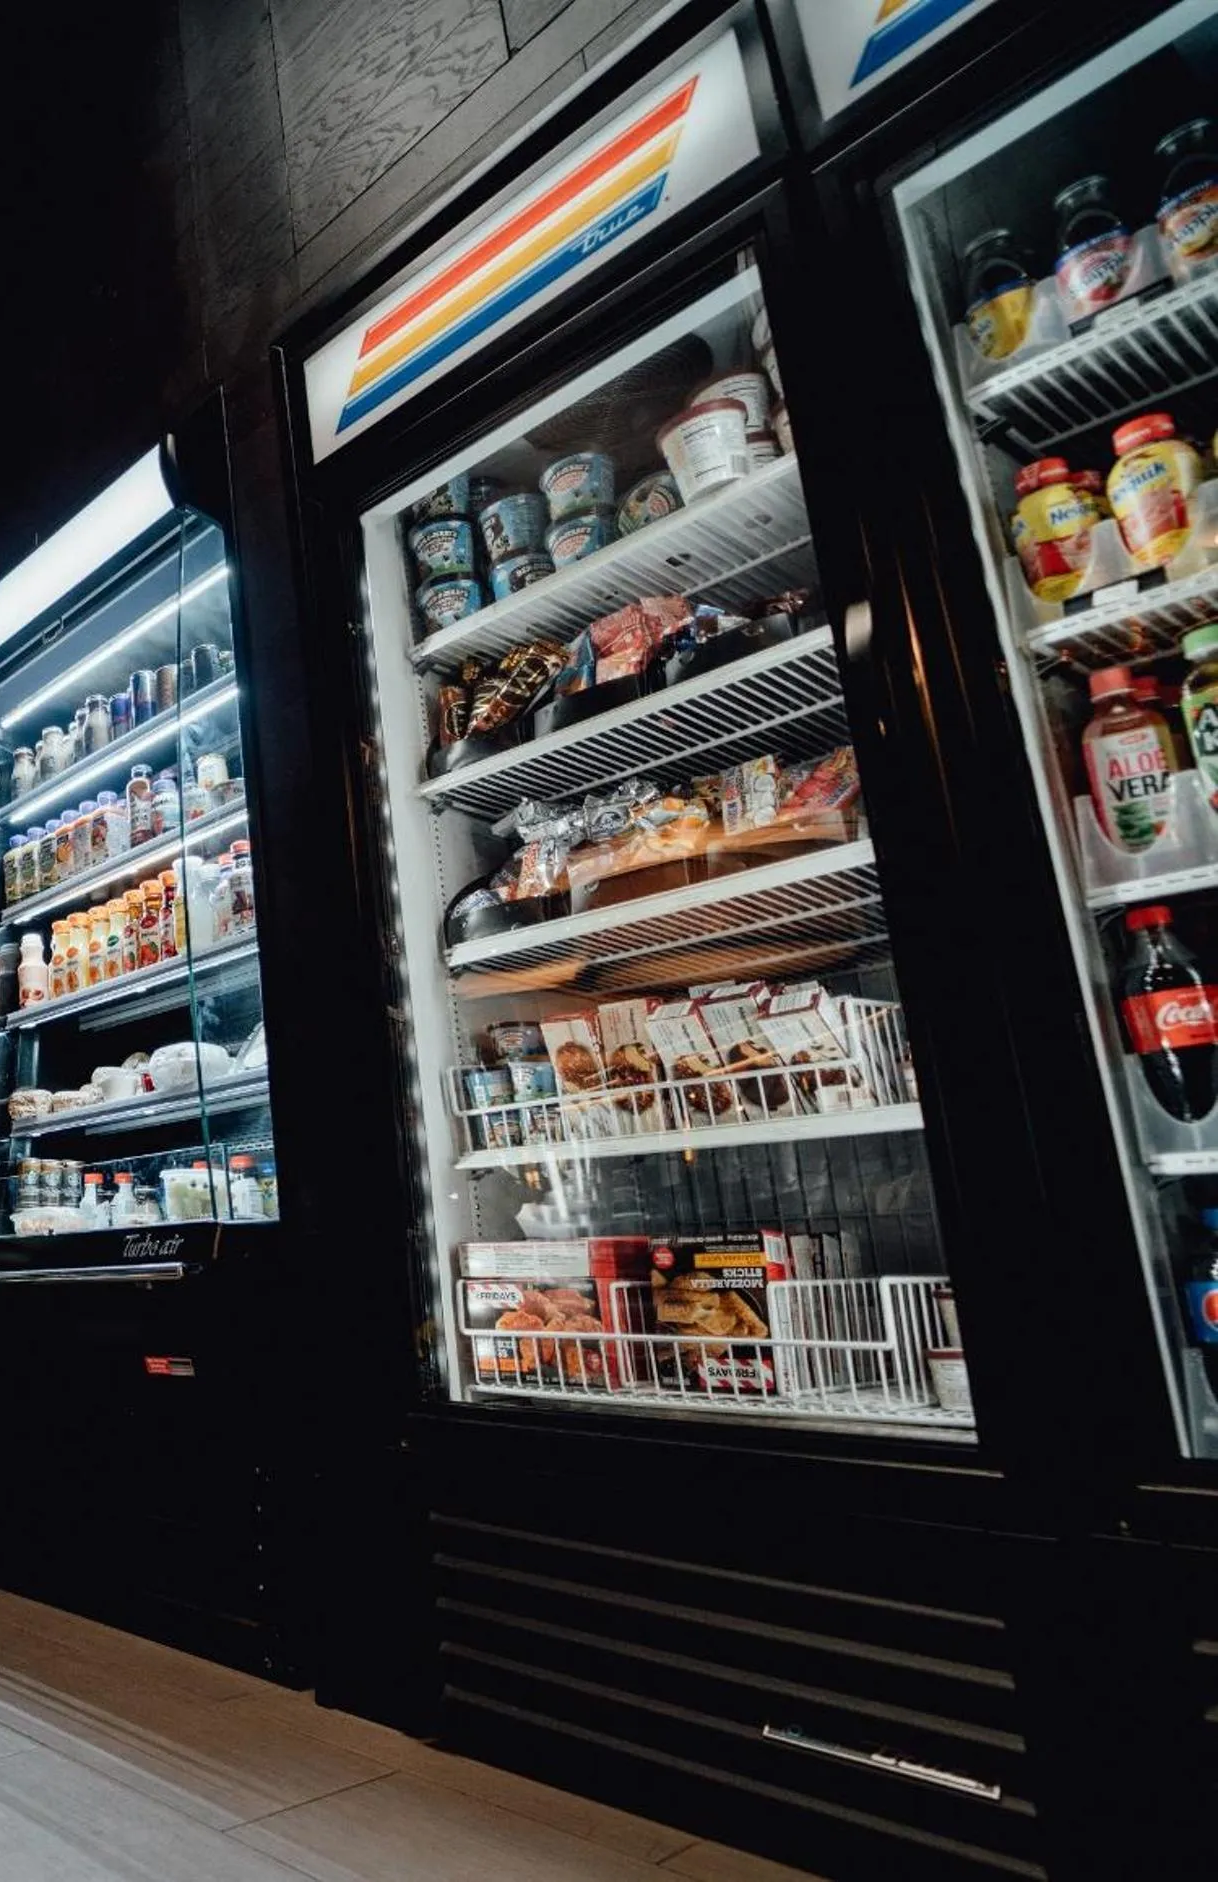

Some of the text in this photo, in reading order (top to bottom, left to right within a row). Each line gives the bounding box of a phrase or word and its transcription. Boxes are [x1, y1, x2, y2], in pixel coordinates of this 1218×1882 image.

[1108, 749, 1166, 780] ALOE
[1107, 771, 1171, 802] VERA
[123, 1233, 185, 1257] Turbo air
[689, 1278, 765, 1289] MOZZARELLA
[479, 1291, 518, 1301] FRIDAYS
[707, 1366, 756, 1379] FRIAYS
